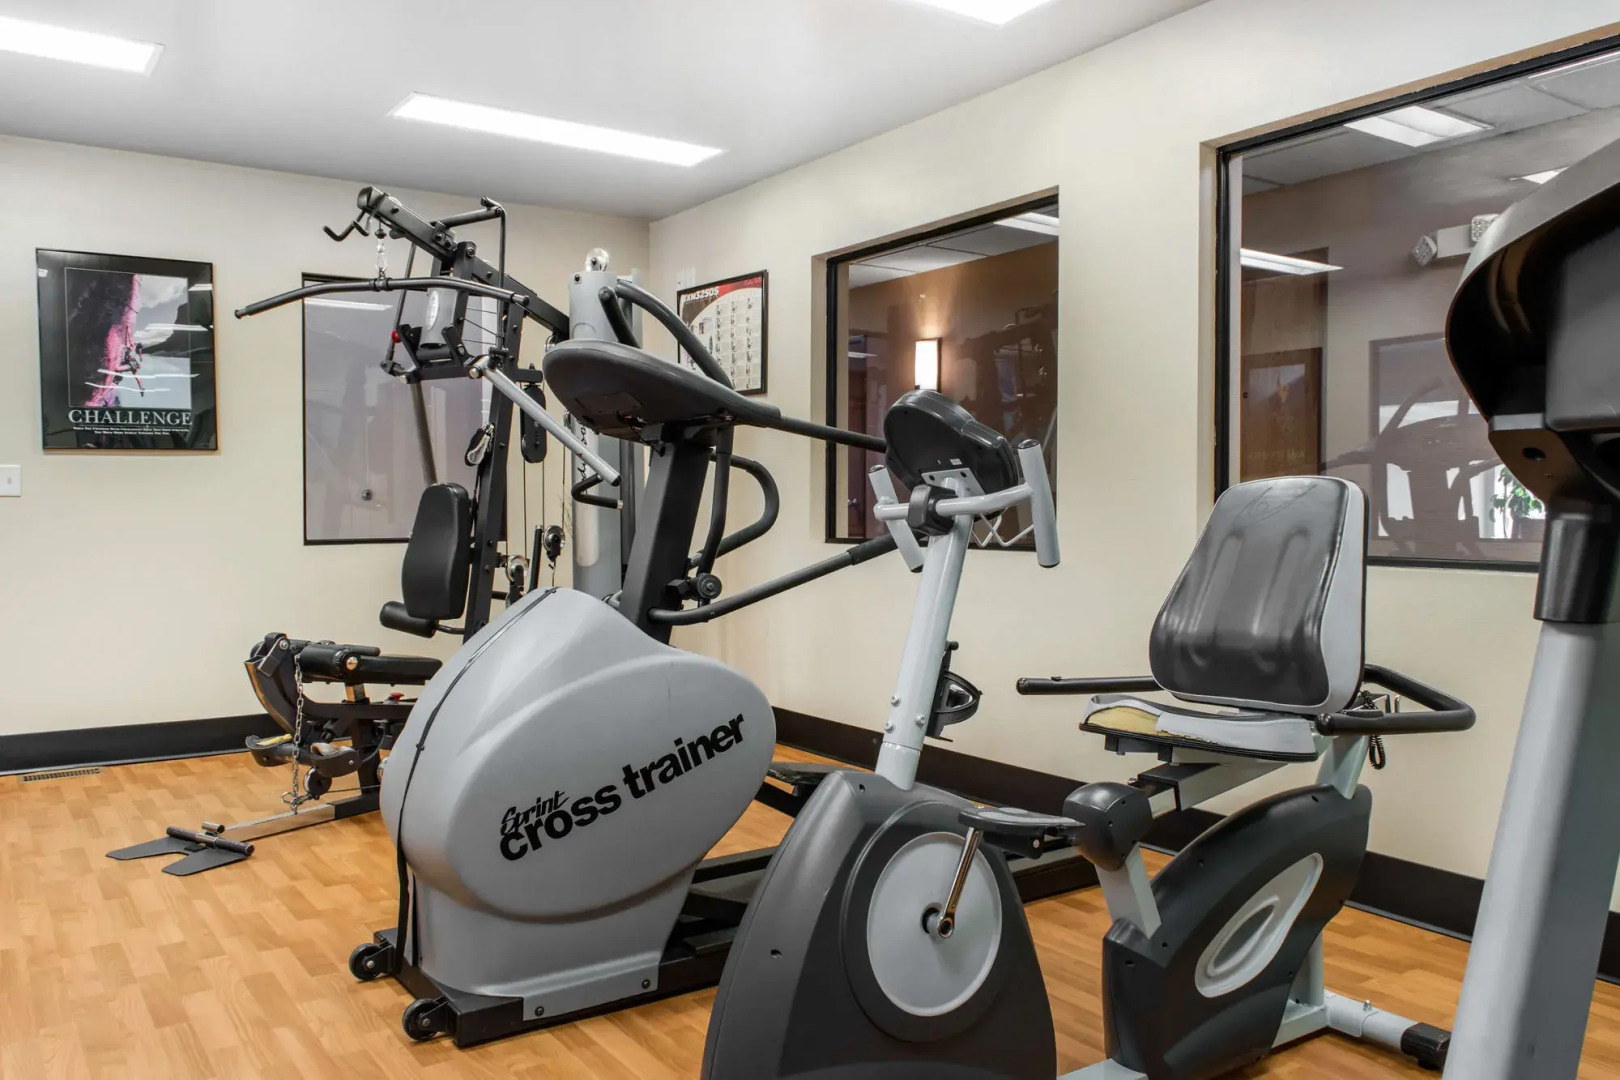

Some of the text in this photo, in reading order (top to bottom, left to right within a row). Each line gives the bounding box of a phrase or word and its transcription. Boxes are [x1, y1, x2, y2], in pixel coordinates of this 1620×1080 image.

[68, 409, 192, 425] CHALLENGE
[500, 713, 745, 861] cross trainer
[500, 790, 570, 837] Sprint
